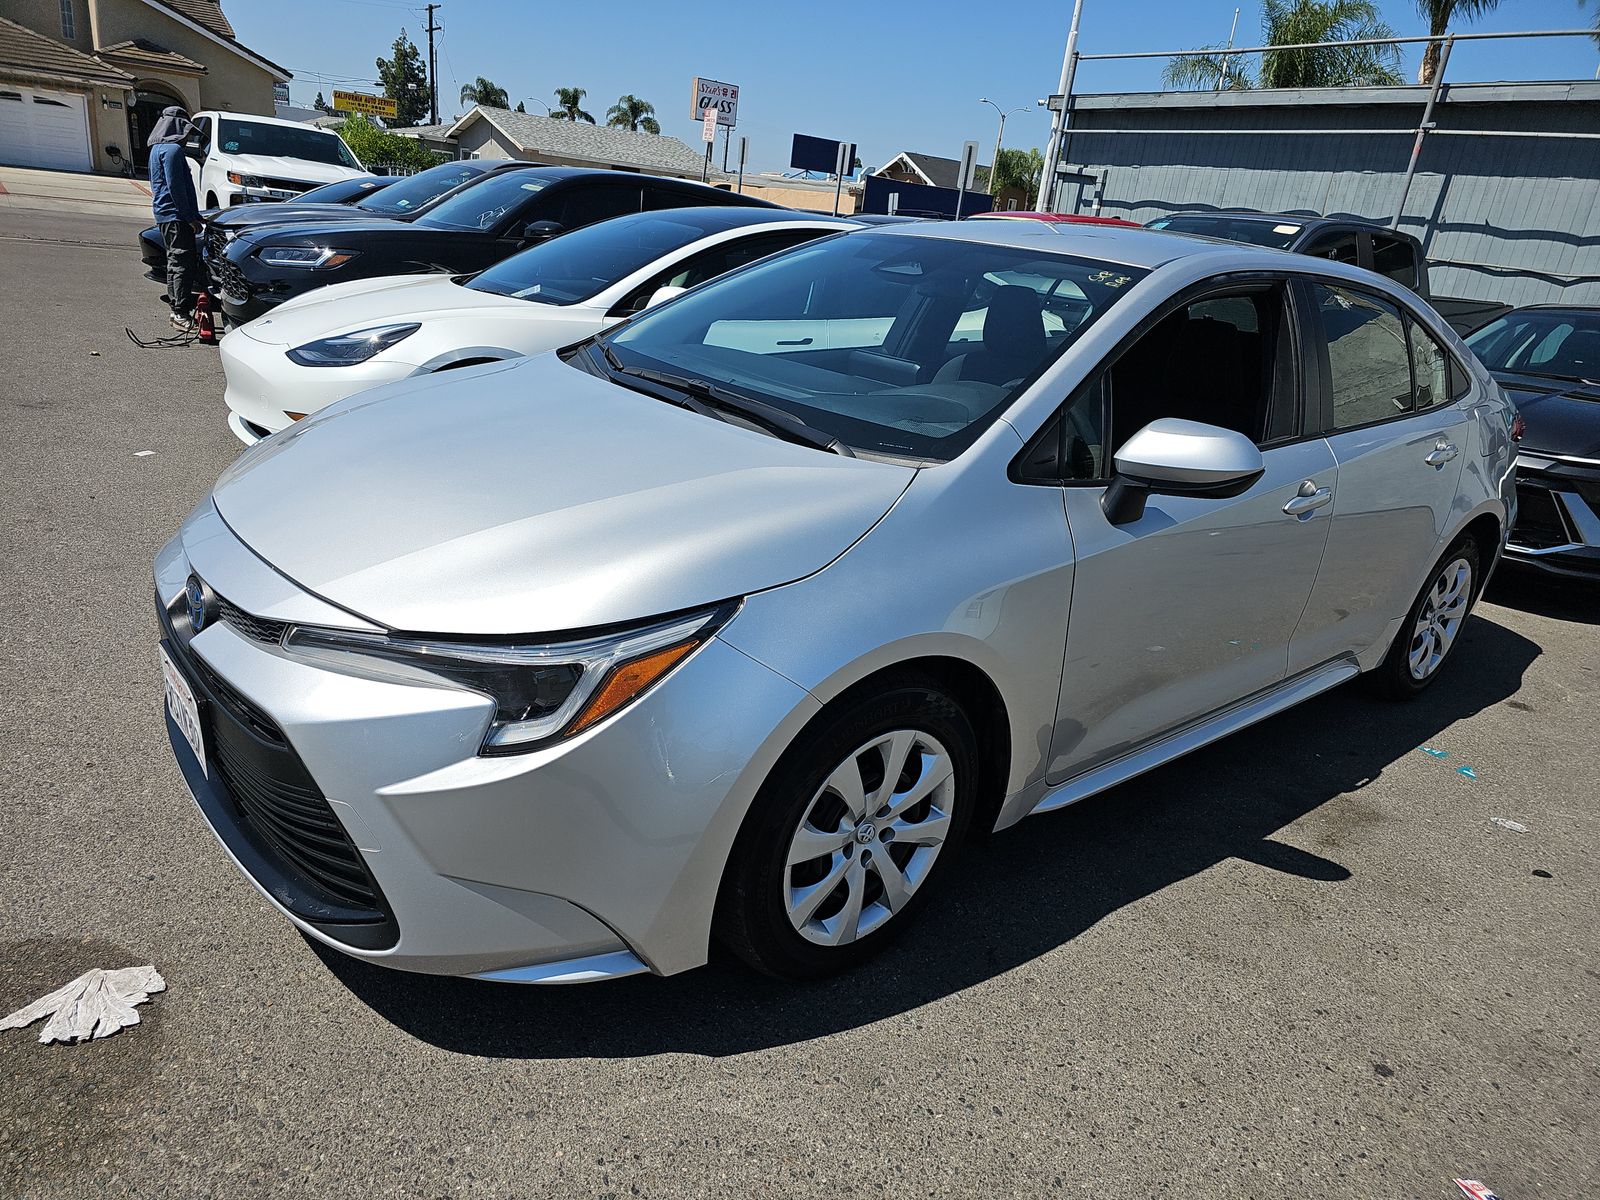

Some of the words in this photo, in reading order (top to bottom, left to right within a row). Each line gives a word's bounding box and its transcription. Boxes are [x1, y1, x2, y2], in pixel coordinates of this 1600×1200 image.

[701, 83, 721, 96] STAR'S
[335, 92, 362, 101] CALIFORNIA
[364, 96, 376, 105] AUTO
[377, 98, 396, 108] SERVICE
[699, 96, 735, 113] GLASS
[375, 109, 395, 117] TOYOTA
